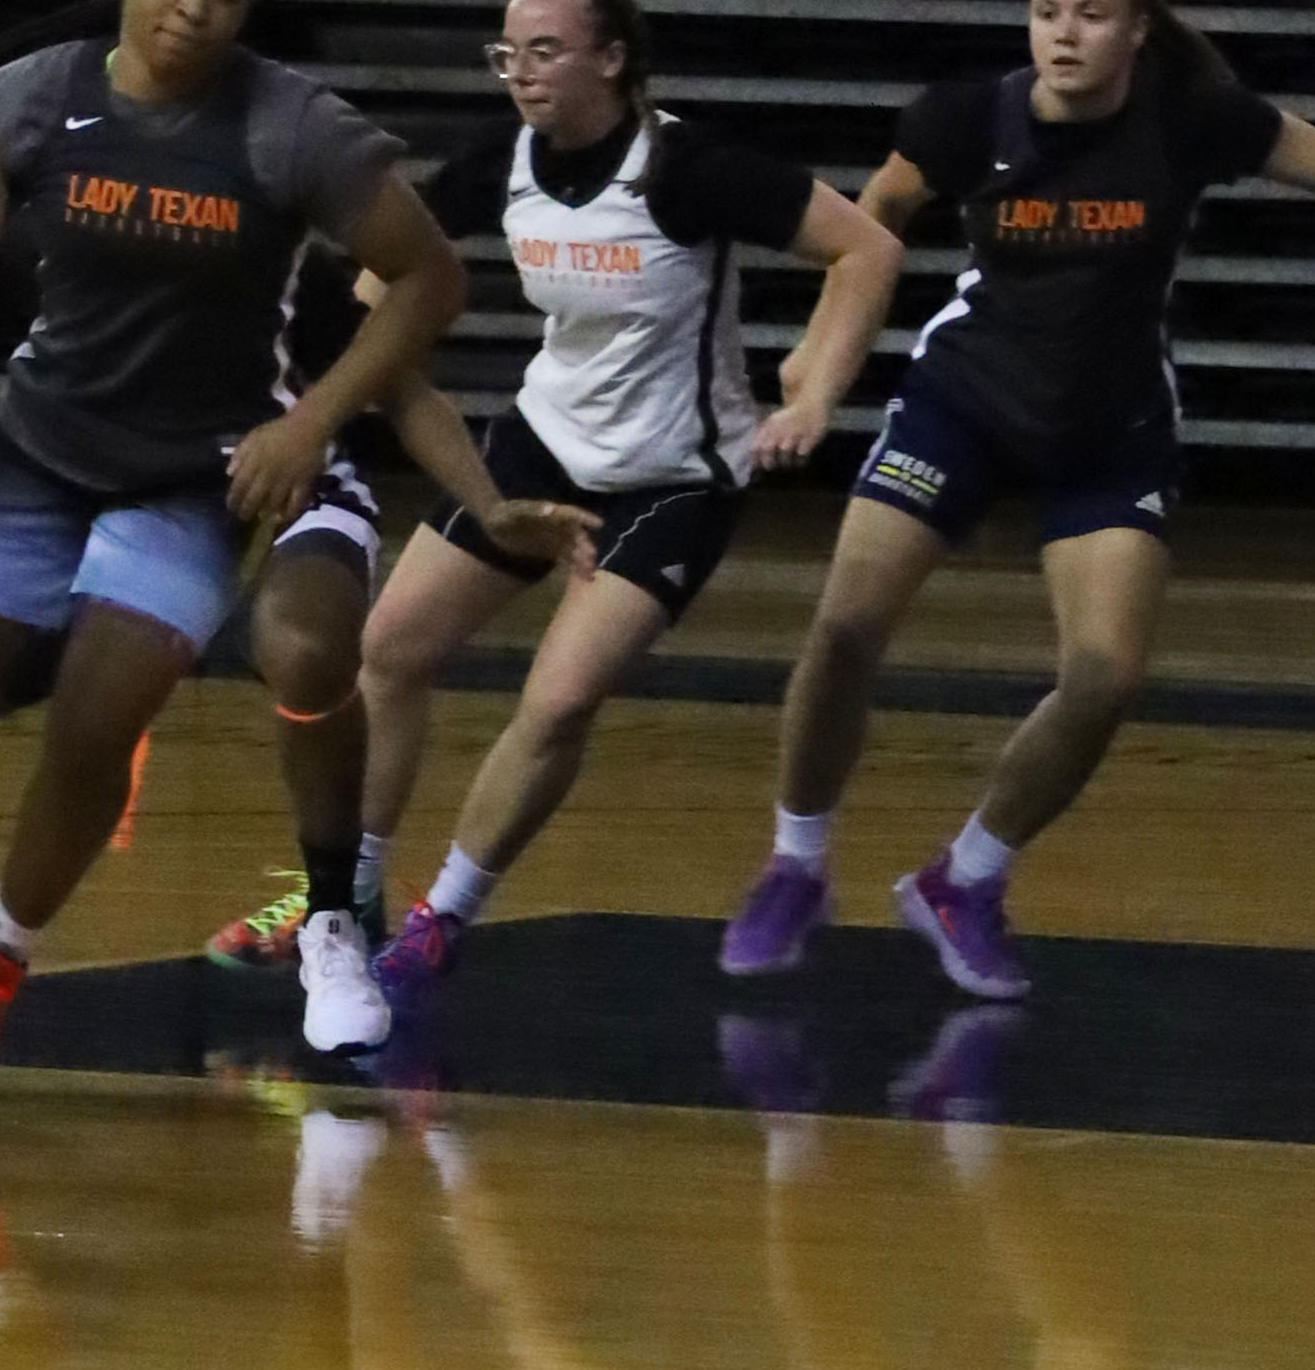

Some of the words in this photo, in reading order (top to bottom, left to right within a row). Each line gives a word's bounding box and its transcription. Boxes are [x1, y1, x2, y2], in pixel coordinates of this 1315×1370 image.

[66, 174, 139, 215] LADY
[149, 185, 240, 233] TEXAN
[997, 199, 1058, 229] LADY
[1067, 200, 1146, 230] TEXAN
[567, 242, 640, 274] TEXAN
[879, 449, 948, 487] SWEDEN
